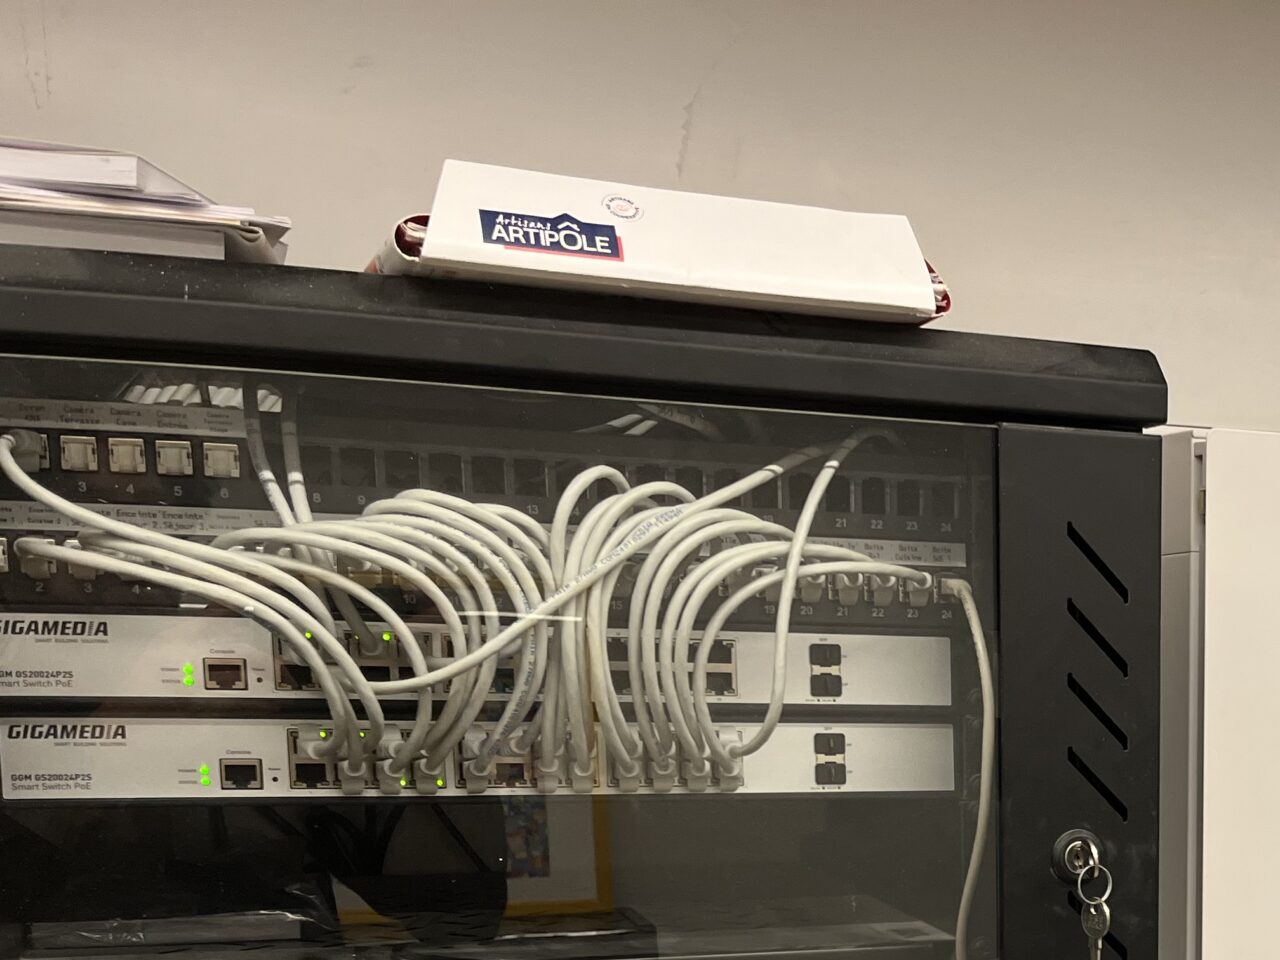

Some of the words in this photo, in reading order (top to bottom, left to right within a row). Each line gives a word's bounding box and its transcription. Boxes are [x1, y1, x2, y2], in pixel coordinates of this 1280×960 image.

[496, 214, 551, 230] Artisans
[491, 221, 612, 254] ARTIPÔLE
[78, 482, 87, 492] 3
[126, 484, 134, 494] 4
[174, 486, 182, 496] 5
[220, 488, 229, 498] 6
[312, 492, 321, 504] 8
[358, 496, 366, 505] 9
[116, 509, 158, 518] Enceinte
[526, 504, 539, 514] 13
[162, 511, 204, 520] Enceinte
[836, 518, 847, 528] 21
[871, 520, 884, 530] 22
[906, 521, 918, 531] 23
[35, 582, 44, 592] 2
[84, 582, 92, 592] 3
[132, 584, 140, 594] 4
[800, 606, 813, 615] 20
[836, 608, 848, 616] 21
[872, 608, 884, 618] 22
[906, 609, 918, 618] 23
[0, 620, 109, 636] IGAMEDIA
[22, 680, 54, 688] Switch
[56, 680, 73, 688] PoE
[7, 724, 128, 740] GIGAMEDIA
[10, 774, 32, 782] GGM
[11, 782, 41, 791] Smart
[44, 782, 72, 791] Switch
[74, 782, 92, 790] PoE
